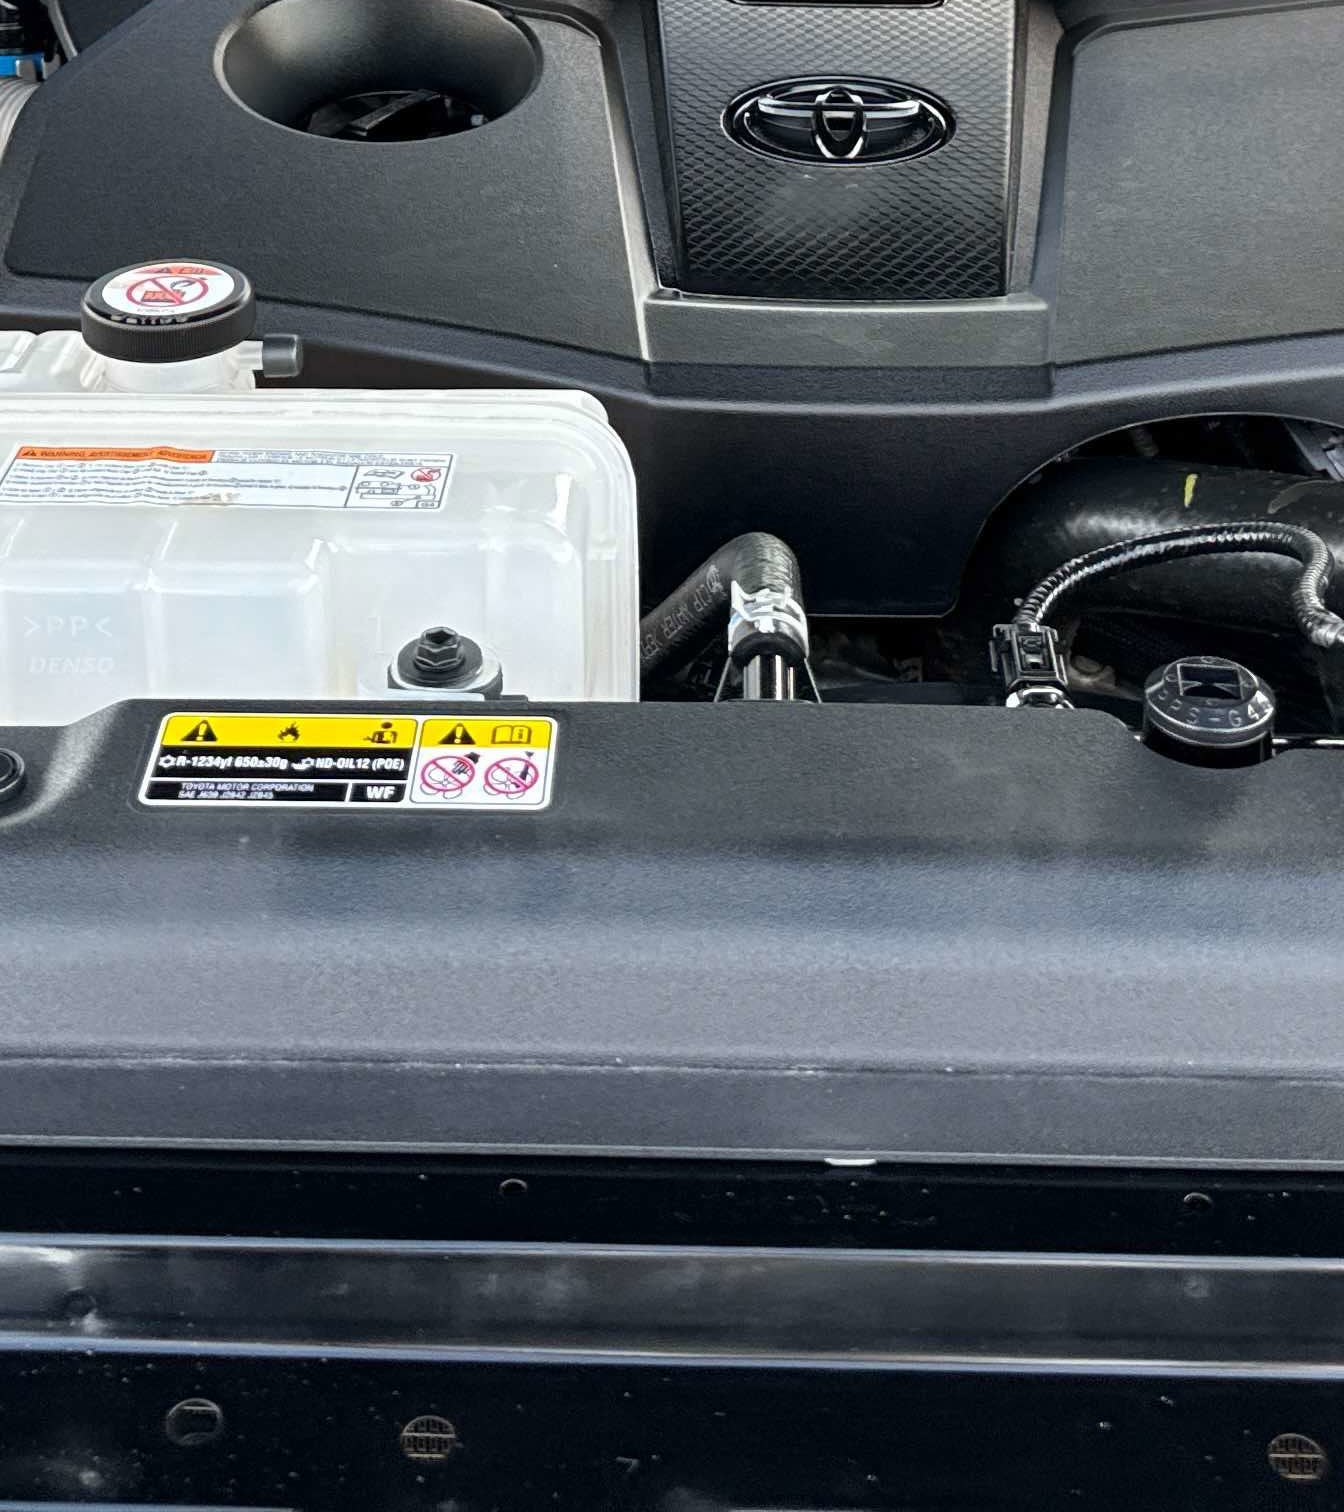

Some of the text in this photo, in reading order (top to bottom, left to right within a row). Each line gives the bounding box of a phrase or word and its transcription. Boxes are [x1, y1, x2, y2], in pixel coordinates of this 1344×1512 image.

[28, 656, 116, 674] DENSO
[176, 755, 233, 769] R-1234yf
[178, 790, 194, 799] SAE
[181, 782, 315, 793] TOYOTA MOTOR CORPORATION
[365, 785, 396, 799] WF
